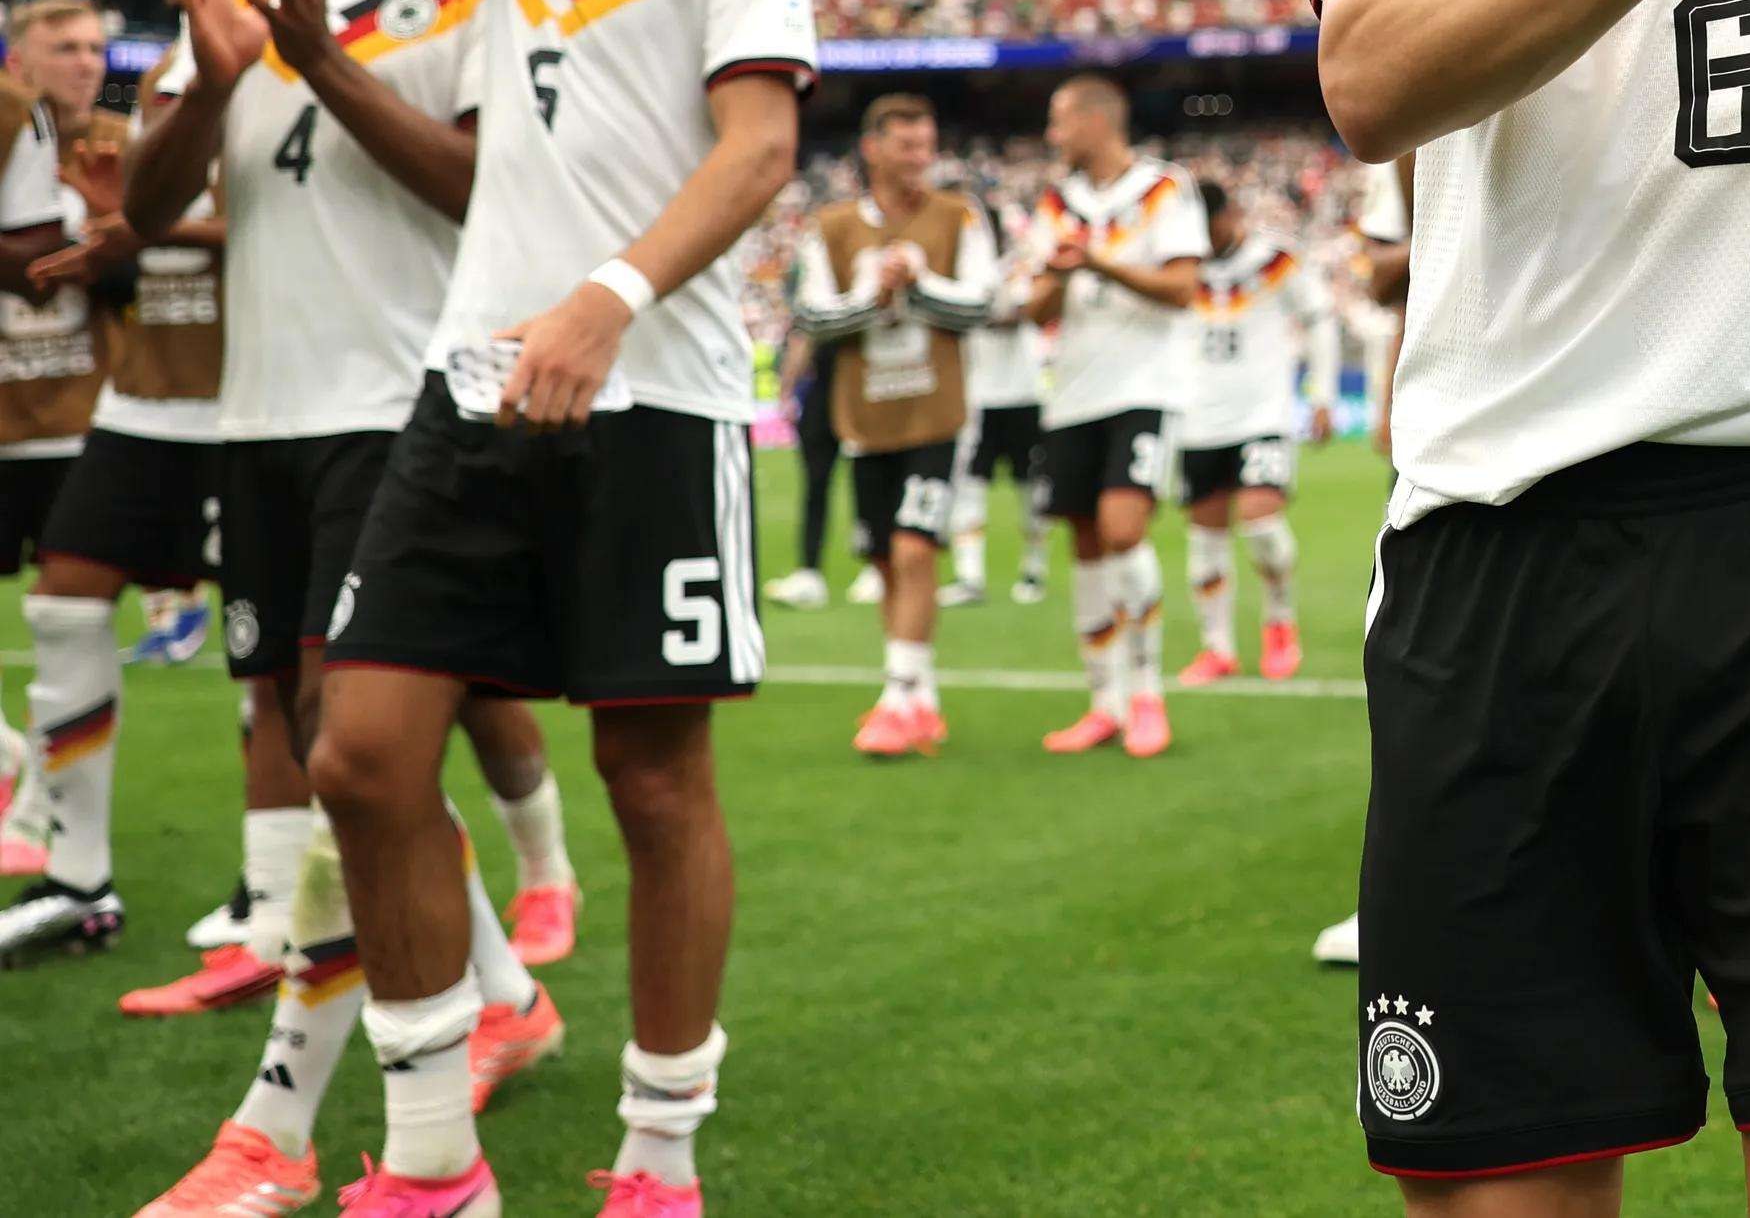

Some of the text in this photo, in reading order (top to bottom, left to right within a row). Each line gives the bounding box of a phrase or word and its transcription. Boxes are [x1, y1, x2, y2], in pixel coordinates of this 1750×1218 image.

[274, 103, 317, 183] 4
[661, 556, 721, 666] 5
[1376, 1034, 1416, 1054] DEUTSCHER
[1375, 1080, 1427, 1108] FUSSBALL-BUND
